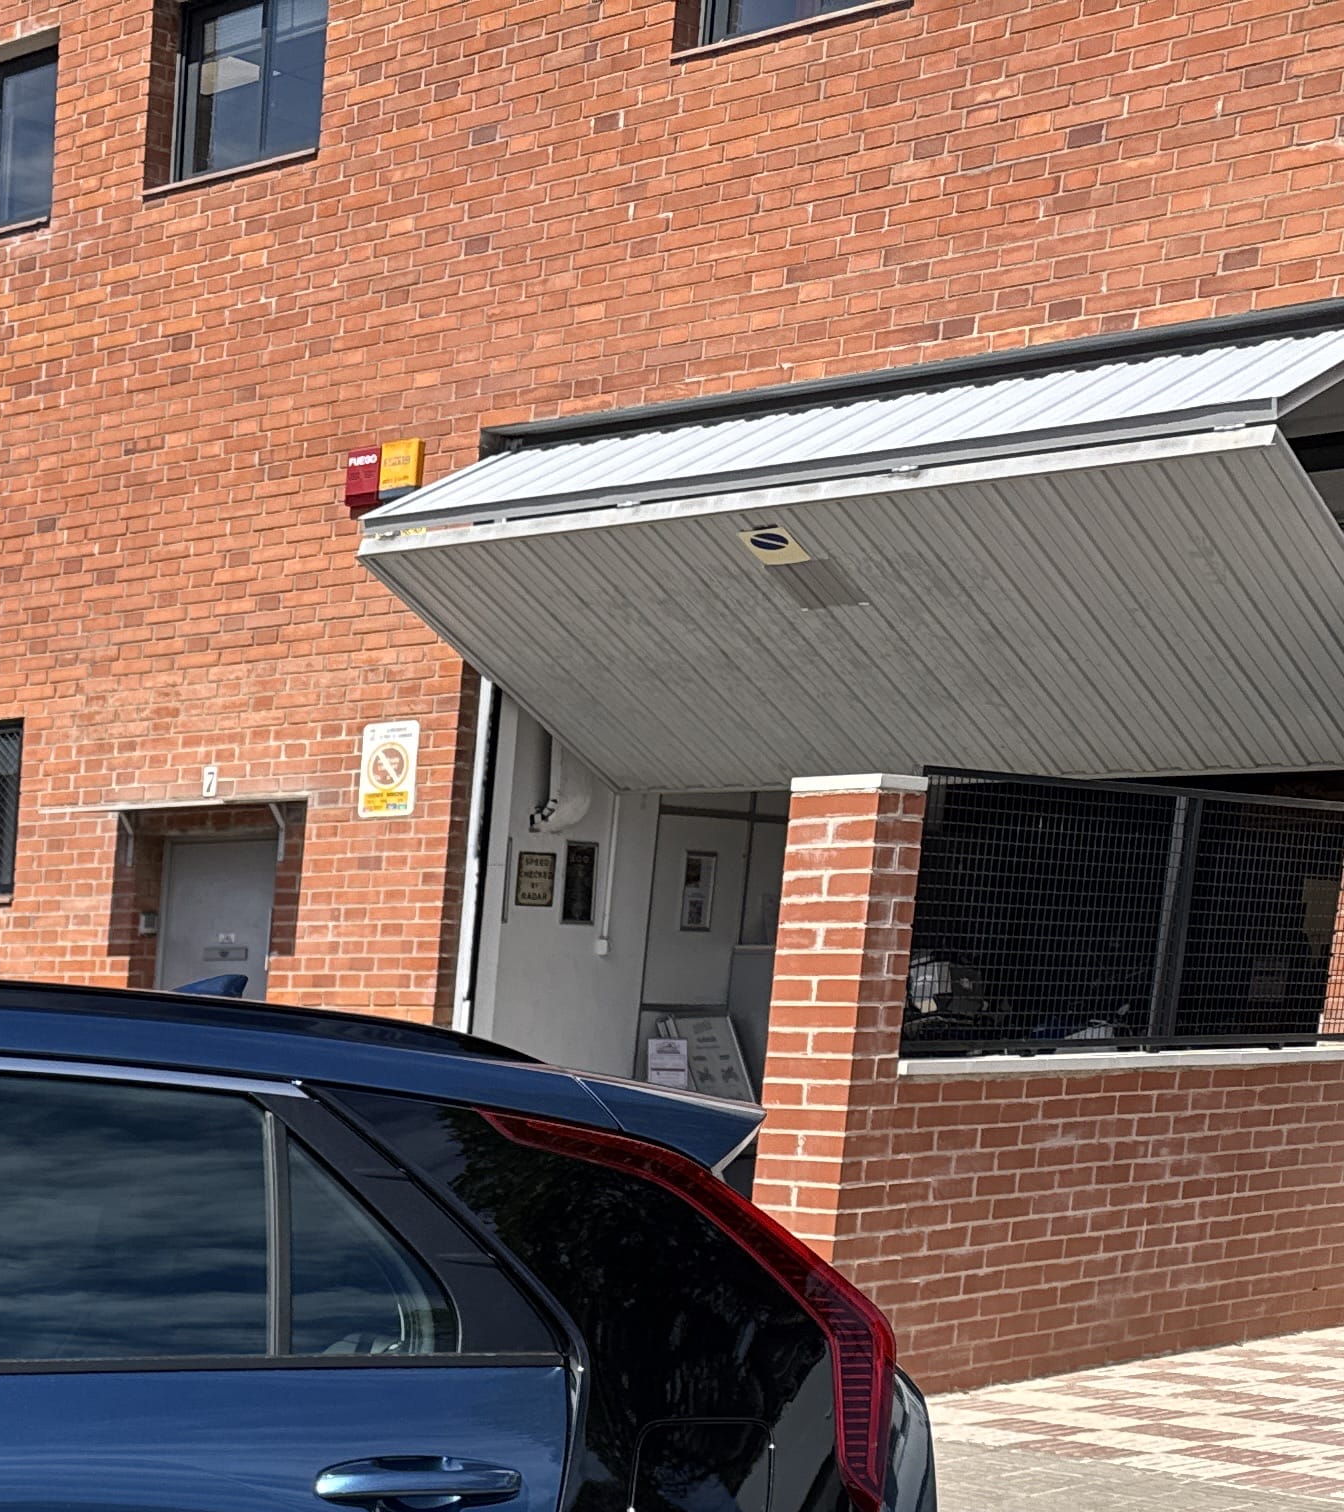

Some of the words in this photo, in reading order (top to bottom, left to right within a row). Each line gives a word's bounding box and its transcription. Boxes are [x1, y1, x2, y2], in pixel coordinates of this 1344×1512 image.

[349, 454, 377, 467] FUEGO
[206, 771, 215, 792] 7
[522, 892, 547, 900] RADAR
